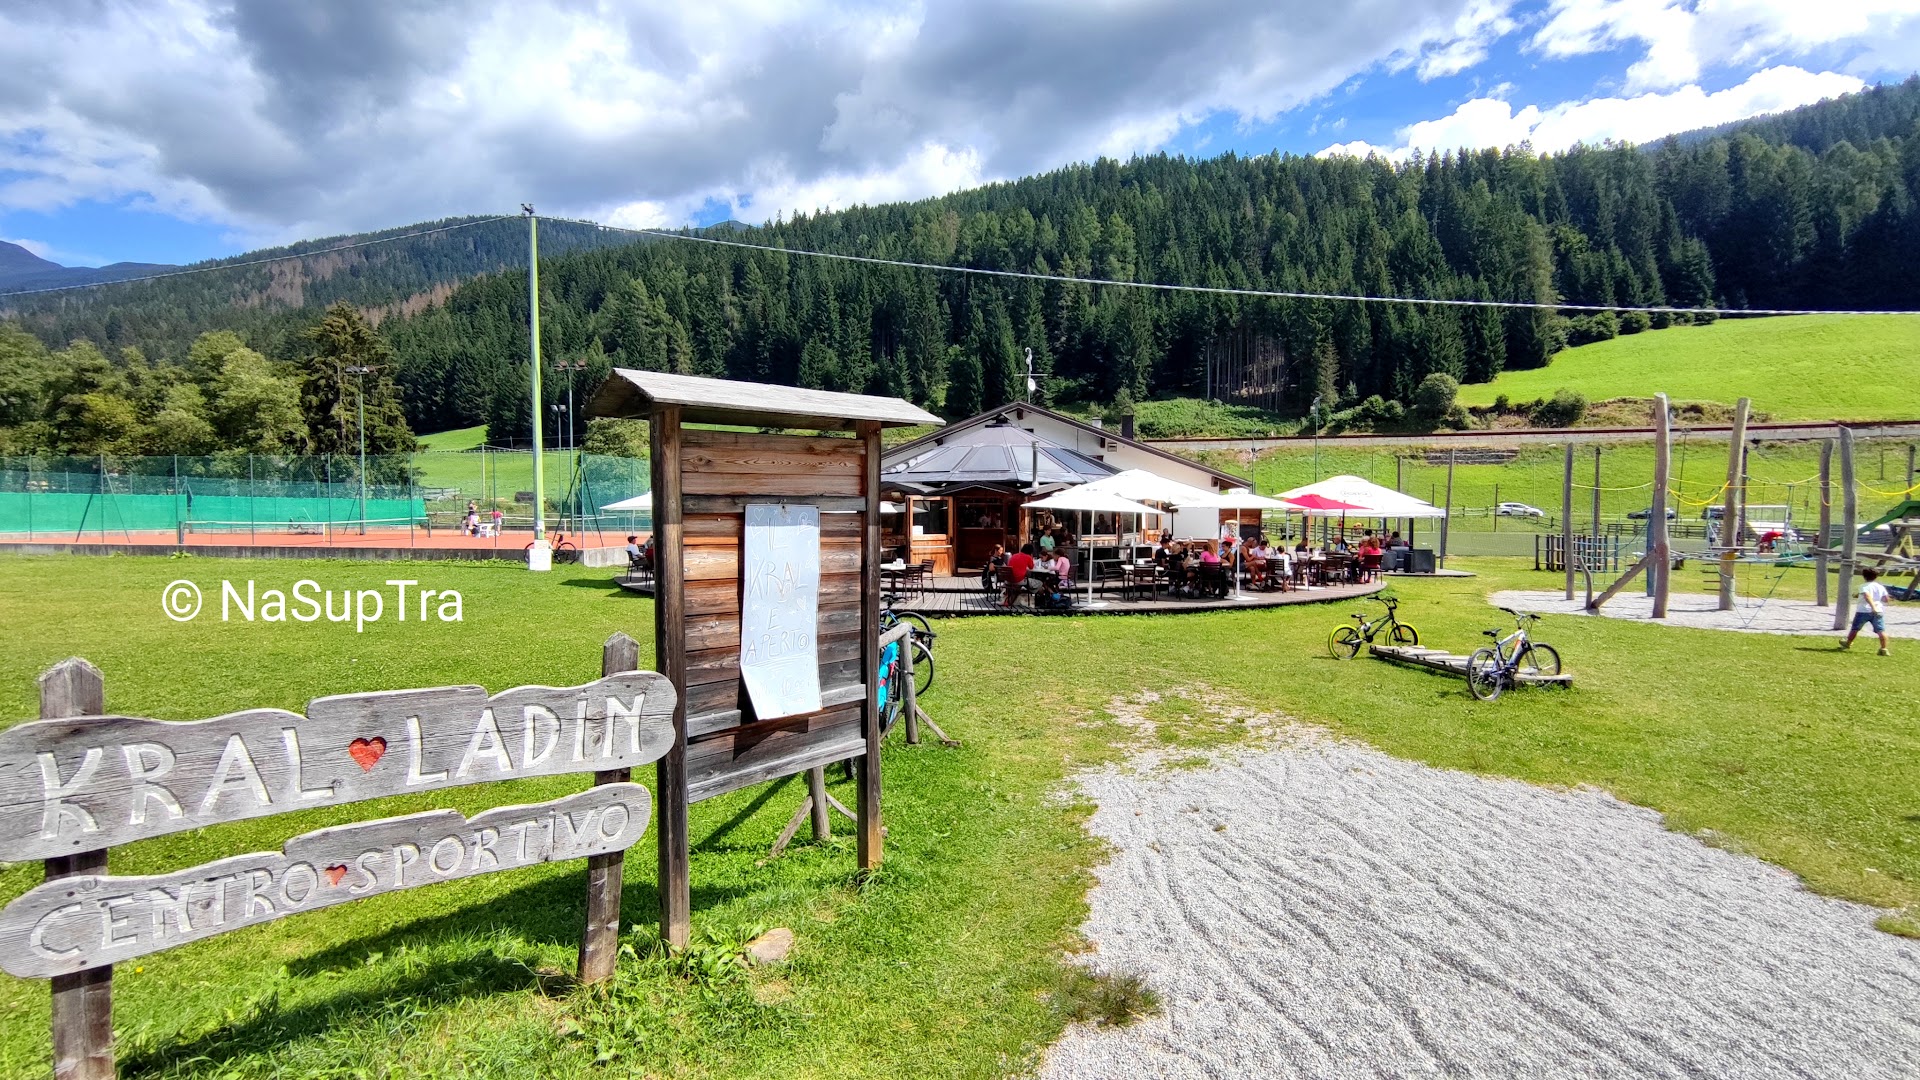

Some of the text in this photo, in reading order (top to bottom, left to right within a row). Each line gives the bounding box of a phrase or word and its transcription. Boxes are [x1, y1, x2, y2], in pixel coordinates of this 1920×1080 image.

[749, 559, 808, 600] KRAL
[743, 629, 811, 664] APERTO
[36, 725, 336, 841] KRAL
[27, 860, 320, 961] CENTRO
